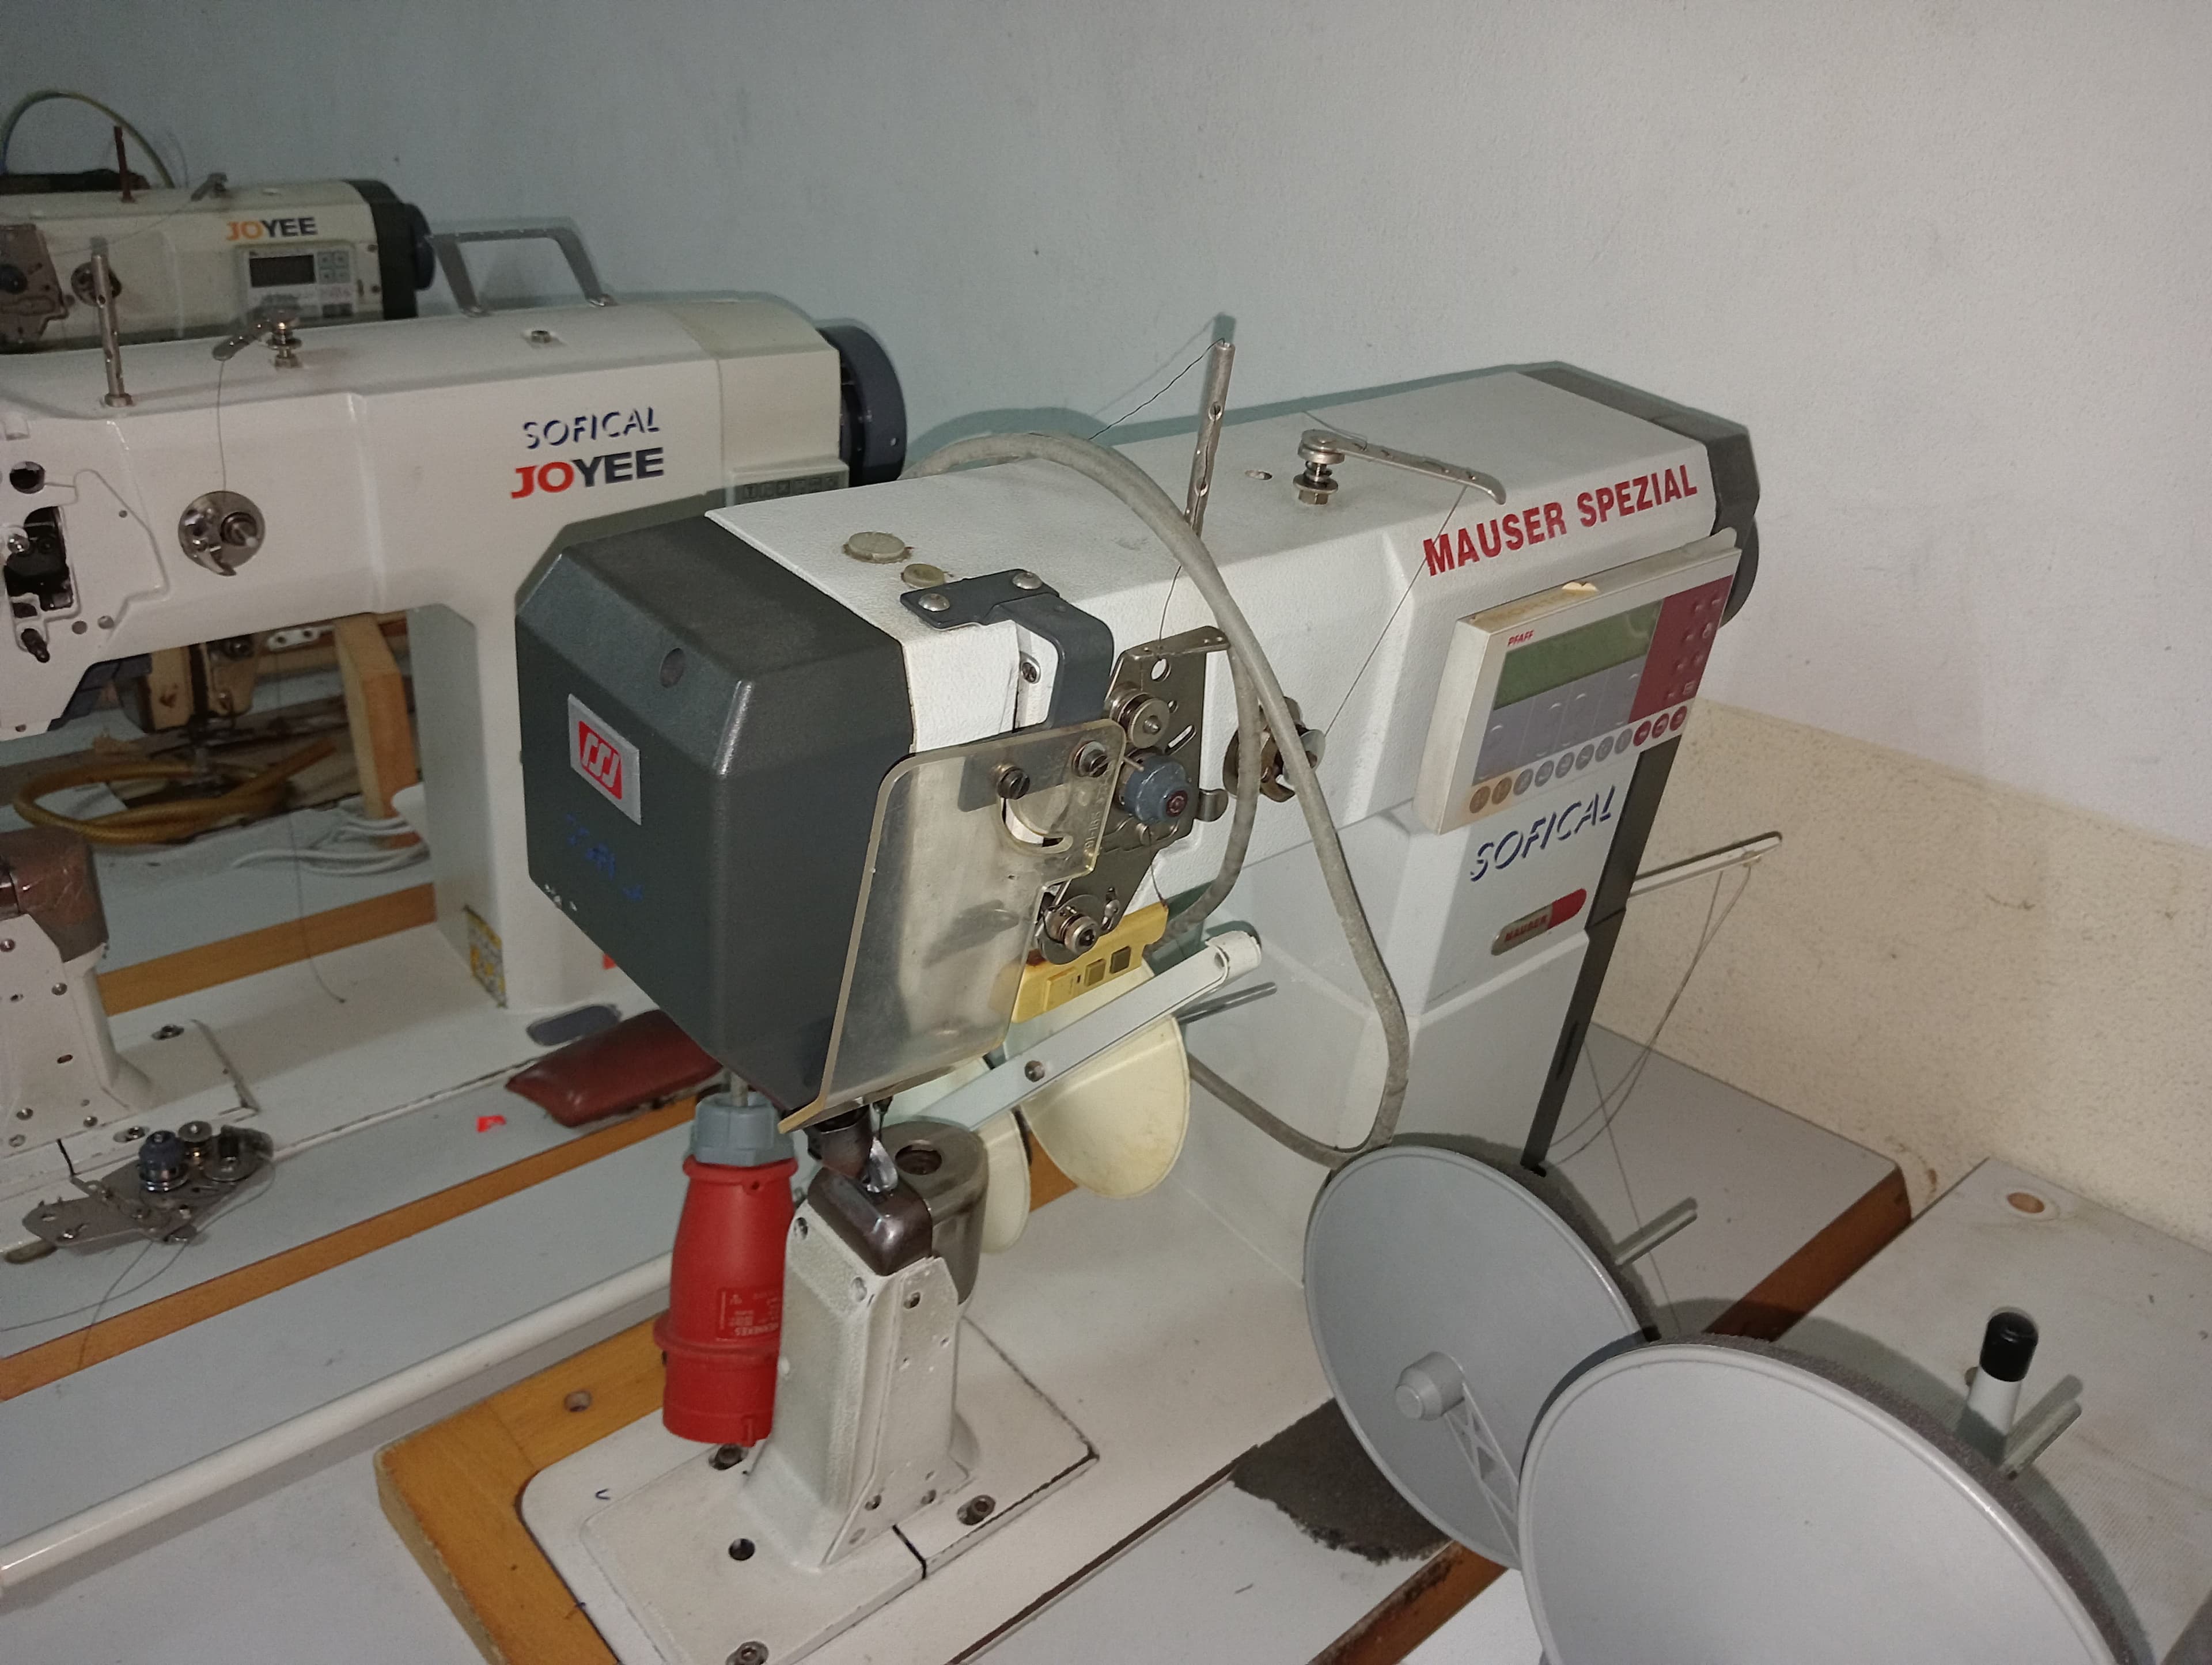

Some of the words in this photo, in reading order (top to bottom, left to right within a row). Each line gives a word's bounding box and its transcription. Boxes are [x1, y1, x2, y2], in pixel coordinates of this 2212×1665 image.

[226, 217, 318, 241] JOYEE
[523, 407, 660, 449] SOFICAL
[510, 447, 665, 499] JOYEE
[1422, 502, 1567, 577] MAUSER
[1577, 464, 1698, 528] SPEZIAL
[1507, 629, 1534, 647] PFAFF
[1469, 784, 1616, 882] SOFICAL
